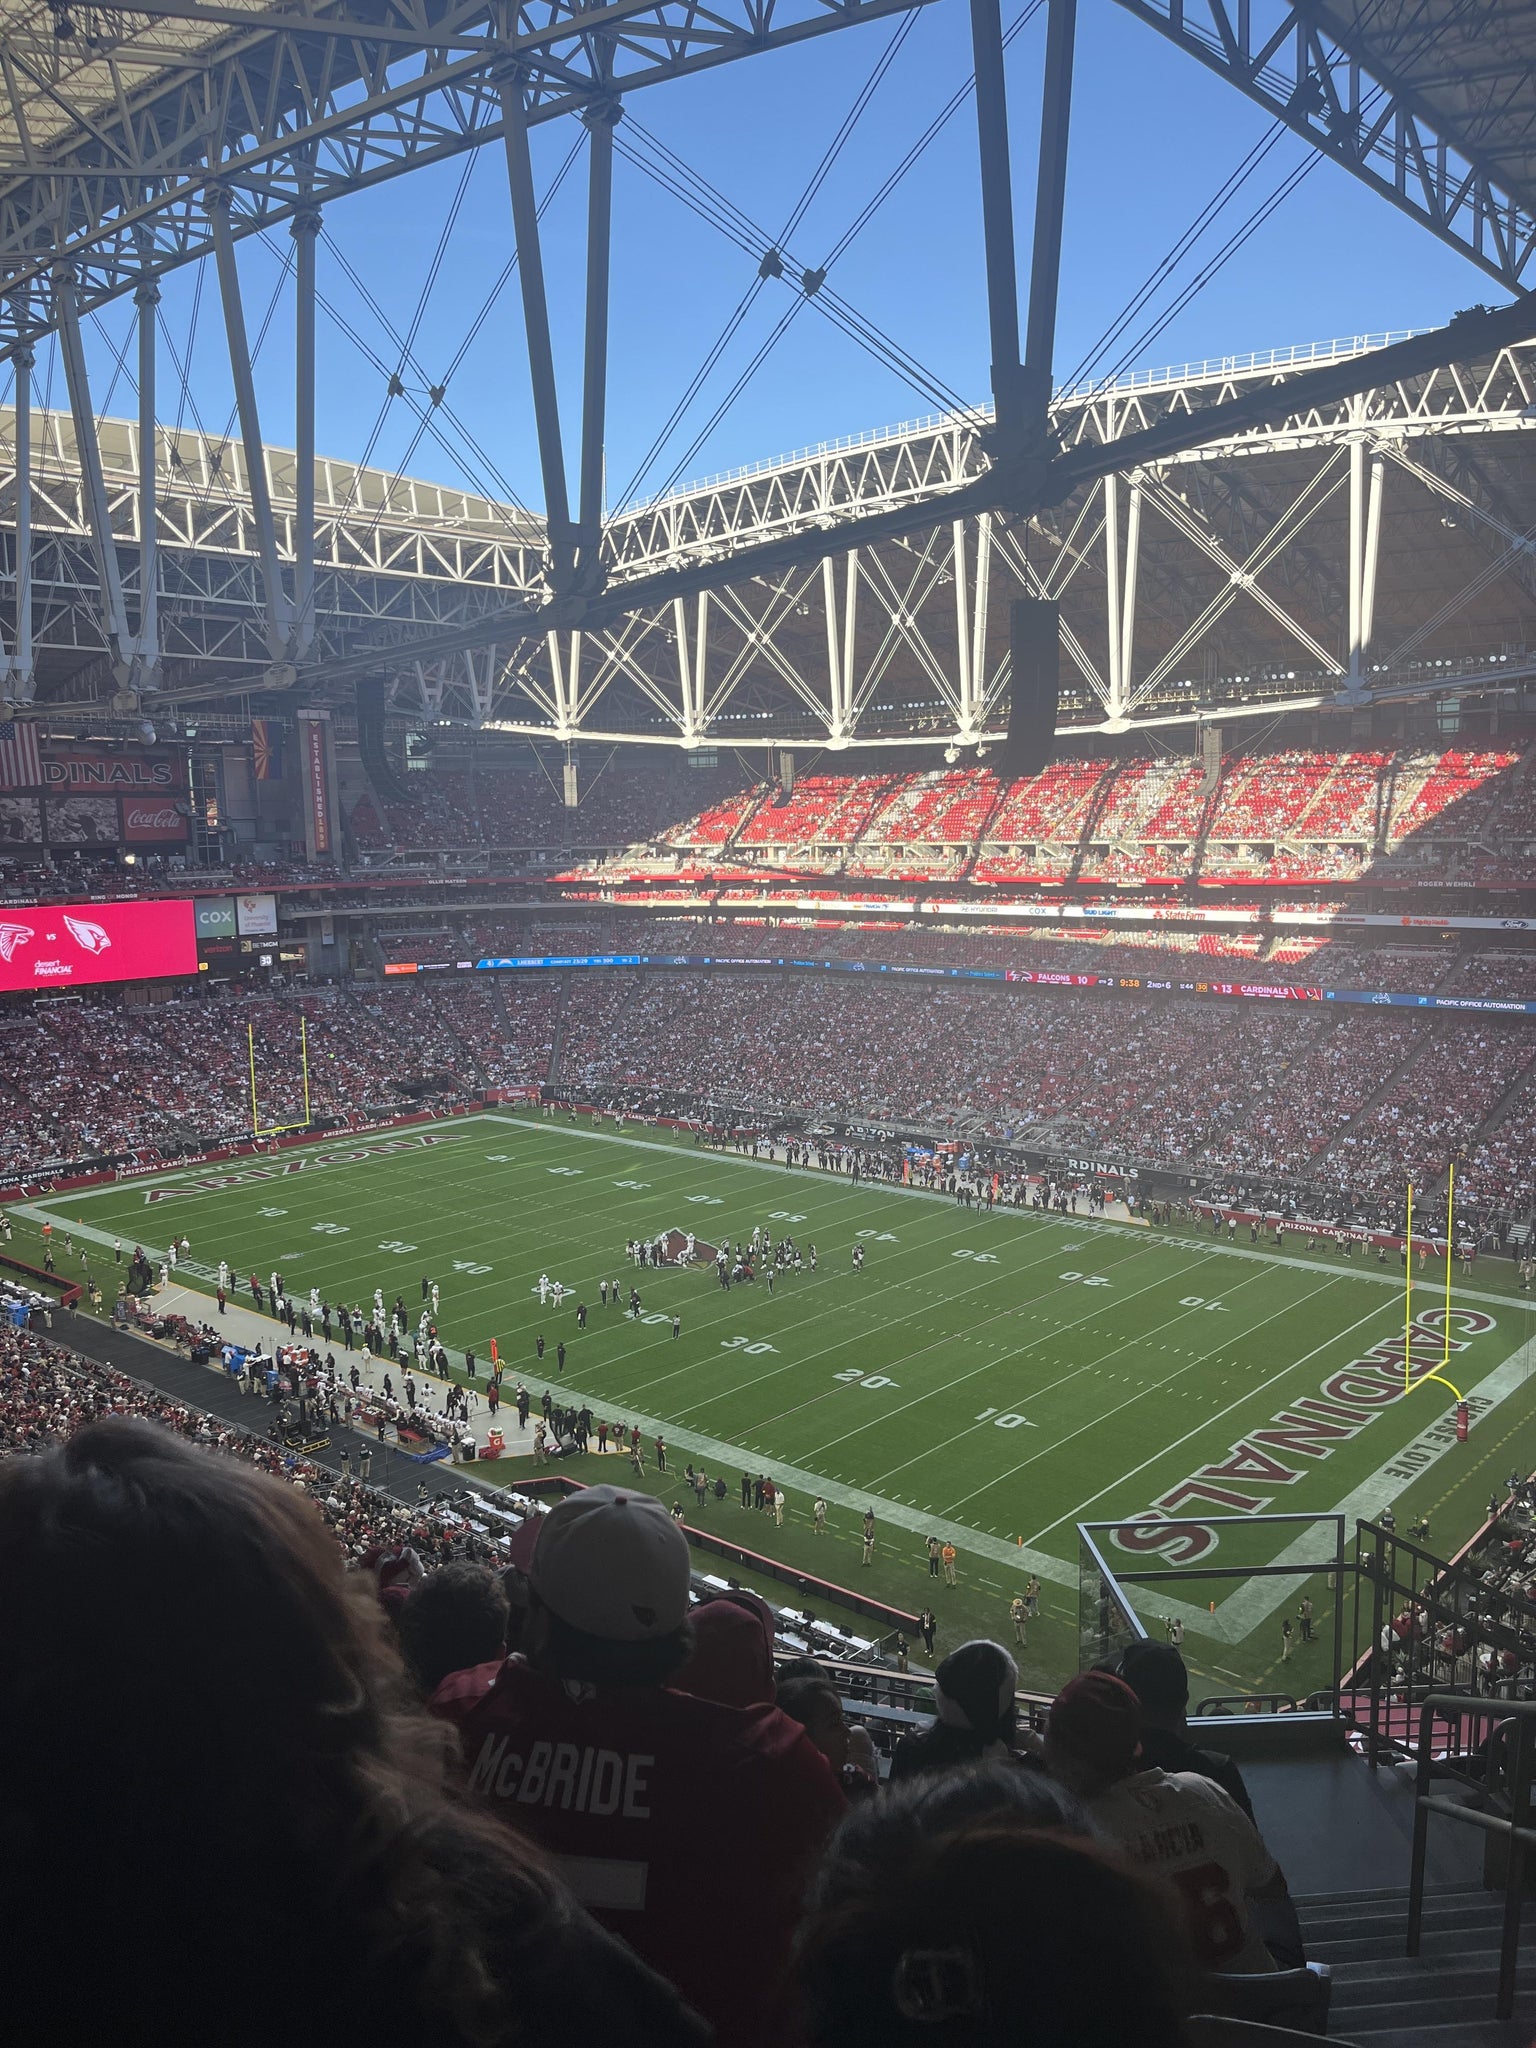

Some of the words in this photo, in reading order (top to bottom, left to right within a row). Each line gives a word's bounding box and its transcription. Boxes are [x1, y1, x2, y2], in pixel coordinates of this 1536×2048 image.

[41, 761, 173, 784] DINALS
[312, 734, 324, 818] ESTABLISHED
[200, 911, 232, 924] COX
[1029, 907, 1047, 915] COX
[252, 941, 279, 949] BETMGM
[34, 960, 61, 968] desert
[261, 956, 272, 965] 30
[34, 965, 73, 976] FINANCIAL
[1038, 973, 1070, 982] FALCONS
[1077, 975, 1088, 985] 10
[1107, 978, 1113, 987] 2
[1119, 979, 1140, 988] 9:38
[1221, 984, 1233, 994] 13
[1240, 985, 1289, 995] CARDINALS
[1436, 999, 1458, 1007] PACIFIC
[1460, 1000, 1482, 1008] OFFICE
[1482, 1001, 1526, 1010] AUTOMATION
[322, 1127, 354, 1139] ARIZONA
[356, 1119, 394, 1132] CARDIALS
[218, 1134, 248, 1144] ARIZONA
[122, 1164, 158, 1176] ARIZONA
[161, 1154, 207, 1169] CARDNALS
[143, 1133, 472, 1205] ARIZONA
[1068, 1158, 1139, 1178] RDINALS
[22, 1168, 64, 1180] CARDINALS
[767, 1211, 808, 1223] 50
[311, 1222, 350, 1234] 20
[1023, 1212, 1113, 1231] INSPIRE
[1119, 1229, 1217, 1250] CHANGE
[1279, 1221, 1319, 1234] ARIZONA
[855, 1229, 896, 1242] 40
[378, 1240, 418, 1254] 30
[951, 1249, 998, 1264] 30
[452, 1260, 493, 1275] 40
[1058, 1271, 1110, 1286] 20
[1178, 1296, 1223, 1311] 10
[720, 1336, 773, 1355] 30
[832, 1368, 892, 1389] 20
[974, 1407, 1027, 1429] 10
[493, 1438, 501, 1446] G
[1108, 1307, 1498, 1567] CARDINALS
[1383, 1443, 1441, 1480] LOVE
[467, 1732, 655, 1819] McBRIDE
